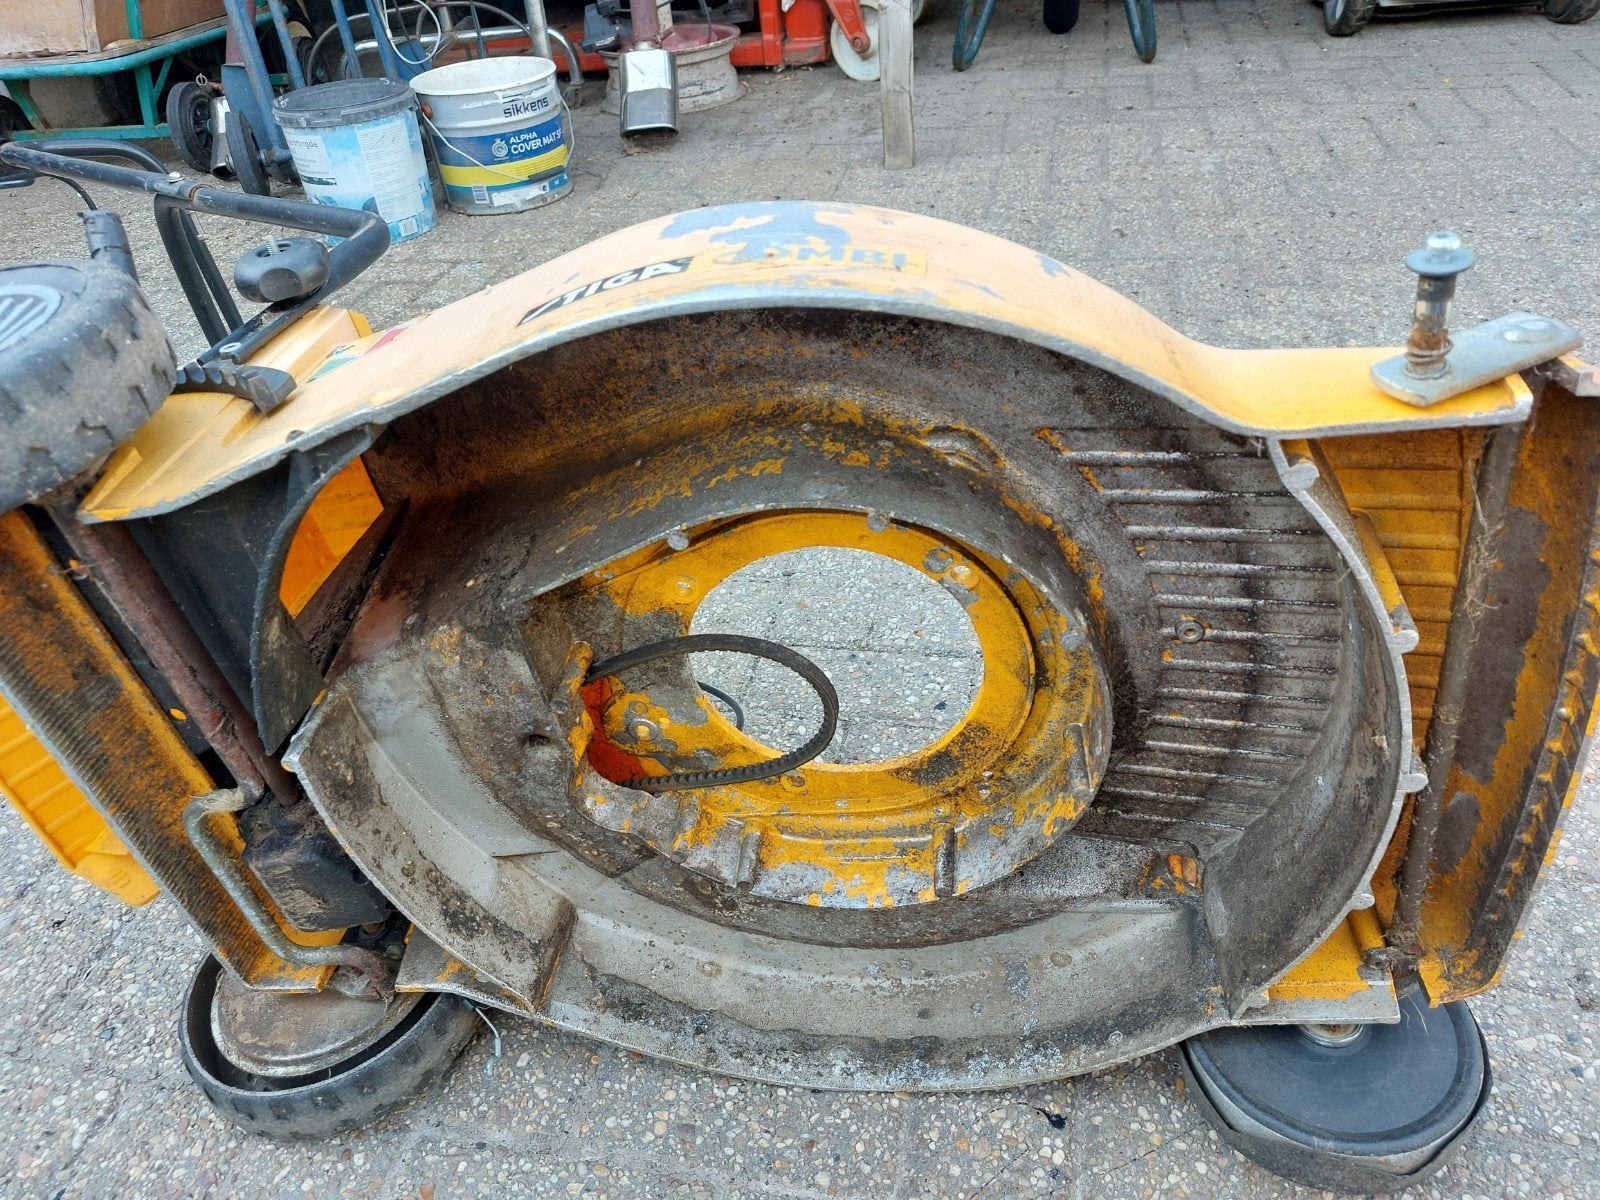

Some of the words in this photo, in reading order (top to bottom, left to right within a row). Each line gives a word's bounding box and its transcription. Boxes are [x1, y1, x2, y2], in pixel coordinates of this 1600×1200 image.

[503, 96, 549, 118] sikkens
[510, 131, 538, 144] ALPHA
[511, 138, 543, 154] COVER
[542, 131, 558, 146] MAT
